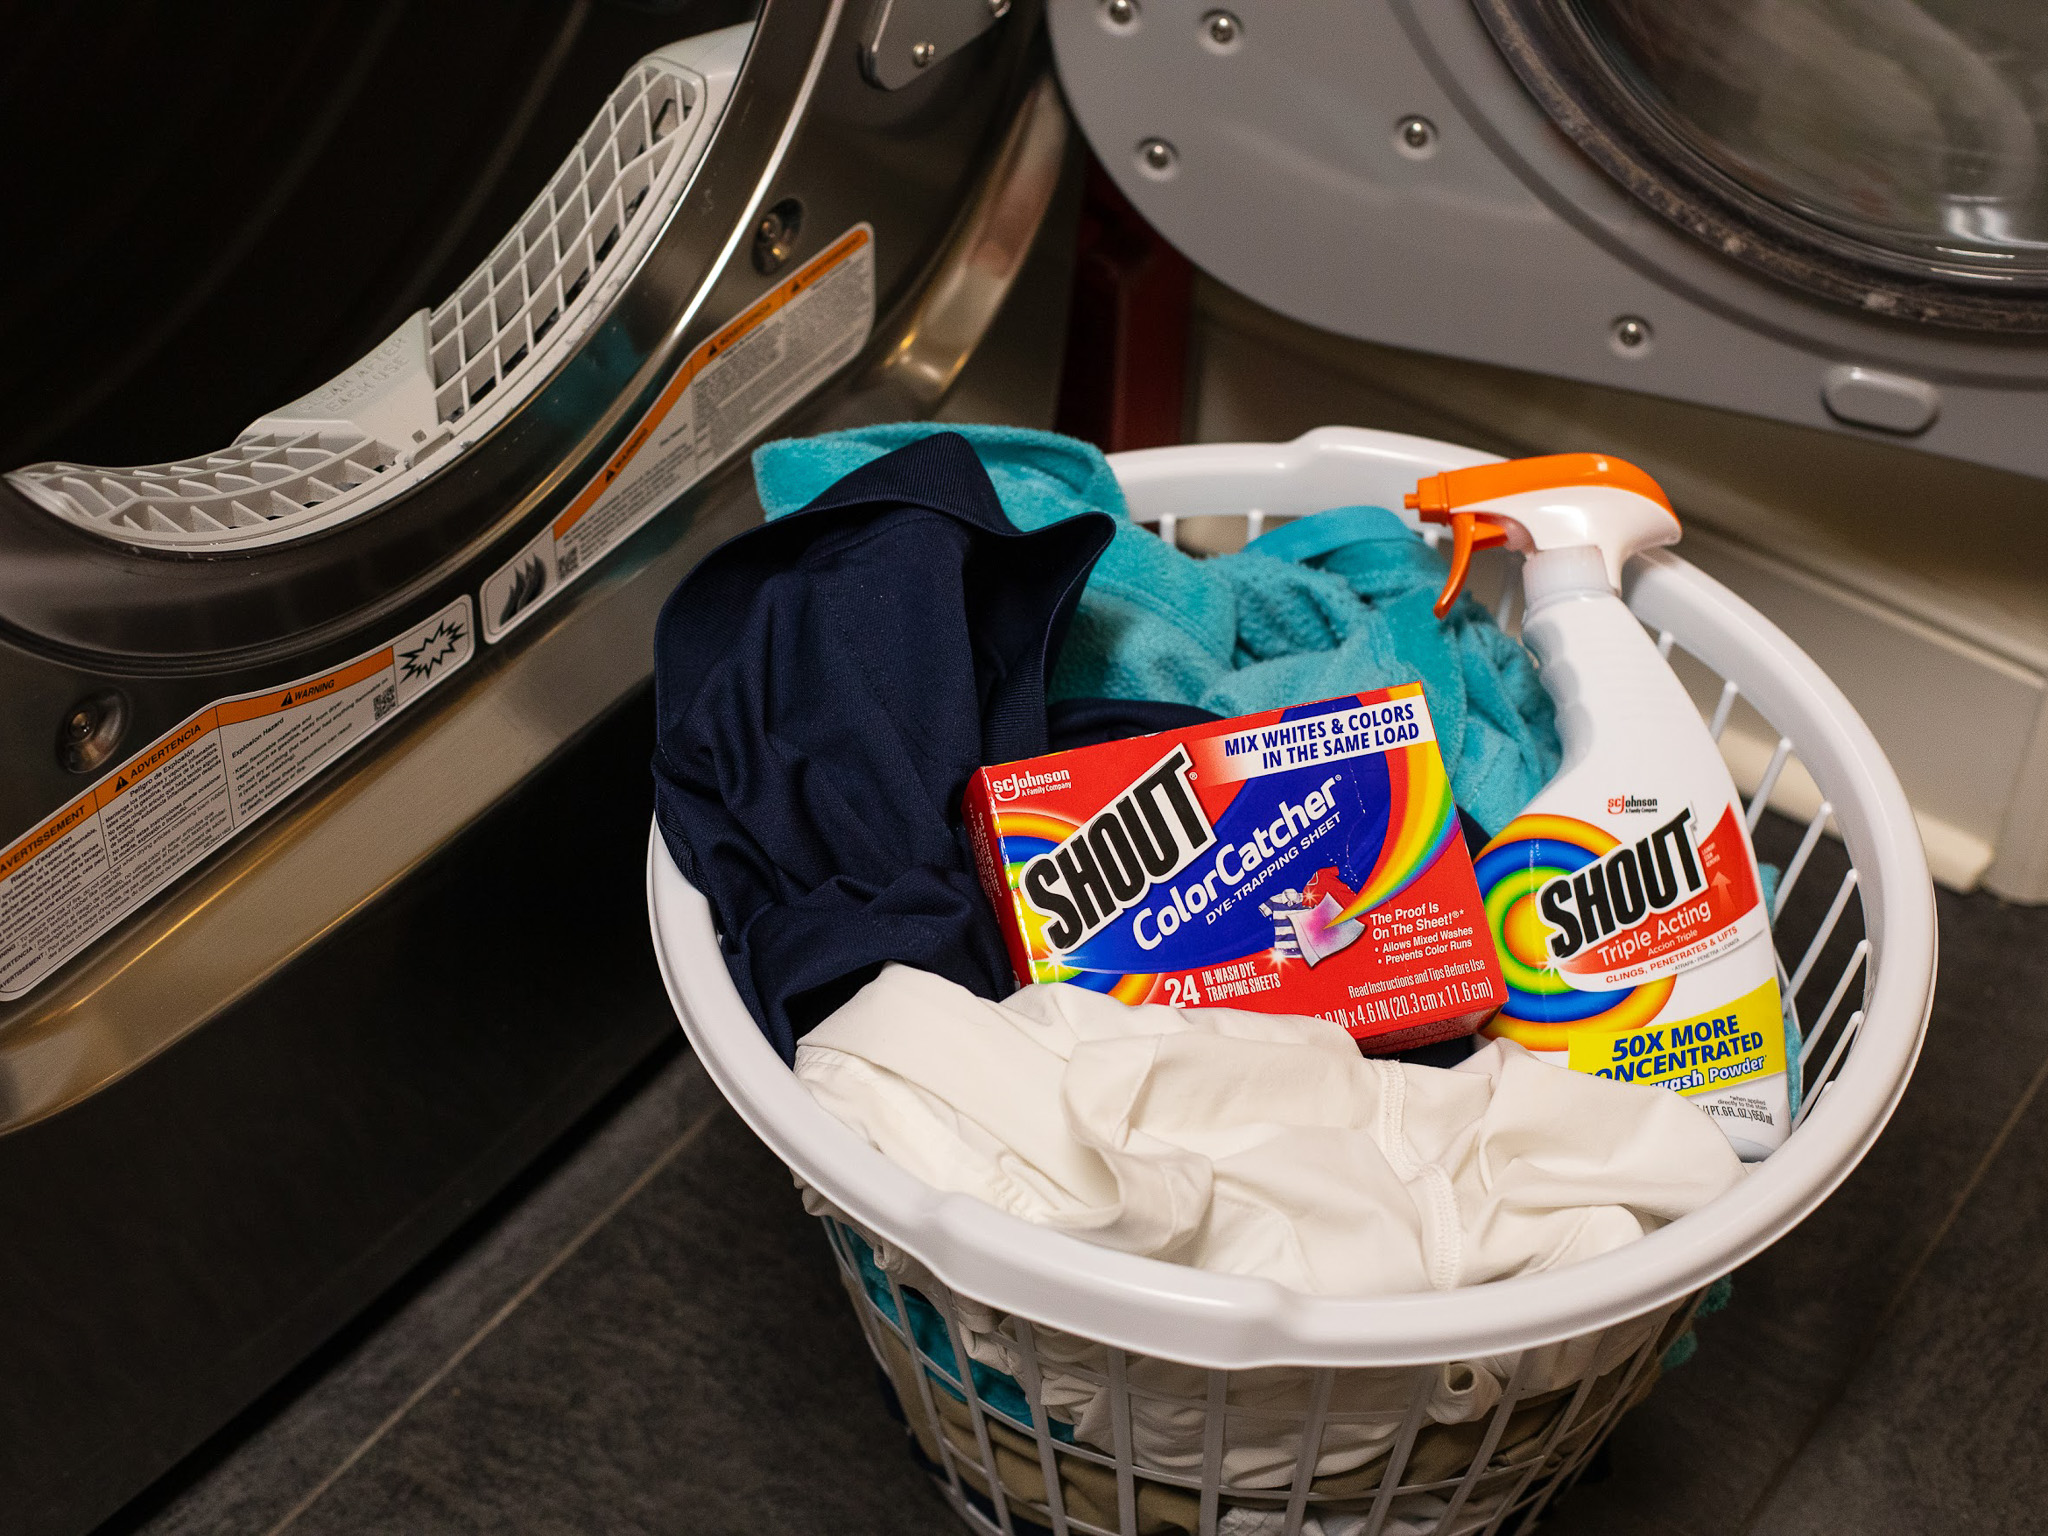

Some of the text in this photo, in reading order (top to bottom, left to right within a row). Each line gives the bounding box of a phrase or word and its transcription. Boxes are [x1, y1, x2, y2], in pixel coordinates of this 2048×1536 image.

[294, 680, 334, 700] WARNING
[231, 716, 284, 758] Explosion Hazard
[1225, 704, 1414, 756] MIX WHITES & COLORS
[1262, 722, 1419, 769] IN THE SAME LOAD
[130, 724, 201, 778] ADVERTENCIA
[129, 748, 194, 797] Peligro de Explosión
[1027, 786, 1045, 796] Family
[1046, 781, 1072, 792] Company
[0, 805, 85, 873] AVERTISSEMENT
[10, 836, 72, 884] Risque d'explosion
[1205, 811, 1341, 925] DYE-TRAPPING SHEET
[1370, 902, 1439, 926] The Proof Is
[1373, 928, 1390, 940] On
[1391, 923, 1413, 936] The
[1597, 901, 1712, 967] Triple Acting
[1382, 926, 1473, 953] Allows Mixed Washes
[1386, 939, 1472, 964] Prevents Color Runs
[1606, 966, 1649, 984] CLINGS,
[1650, 942, 1708, 971] PENETRATES
[1717, 926, 1737, 942] LIFTS
[1647, 928, 1698, 957] Accion Triple
[1164, 974, 1201, 1008] 24
[1202, 961, 1257, 986] IN-WASH DYE
[1206, 973, 1281, 1002] TRAPPING SHEETS
[1348, 959, 1486, 998] Read Instructions and Tips Before Use
[1349, 1011, 1357, 1027] x
[1356, 1002, 1376, 1026] 4.6
[1437, 991, 1447, 1008] x
[1586, 1031, 1763, 1083] ONCENTRATED
[1612, 1014, 1740, 1062] 50X MORE
